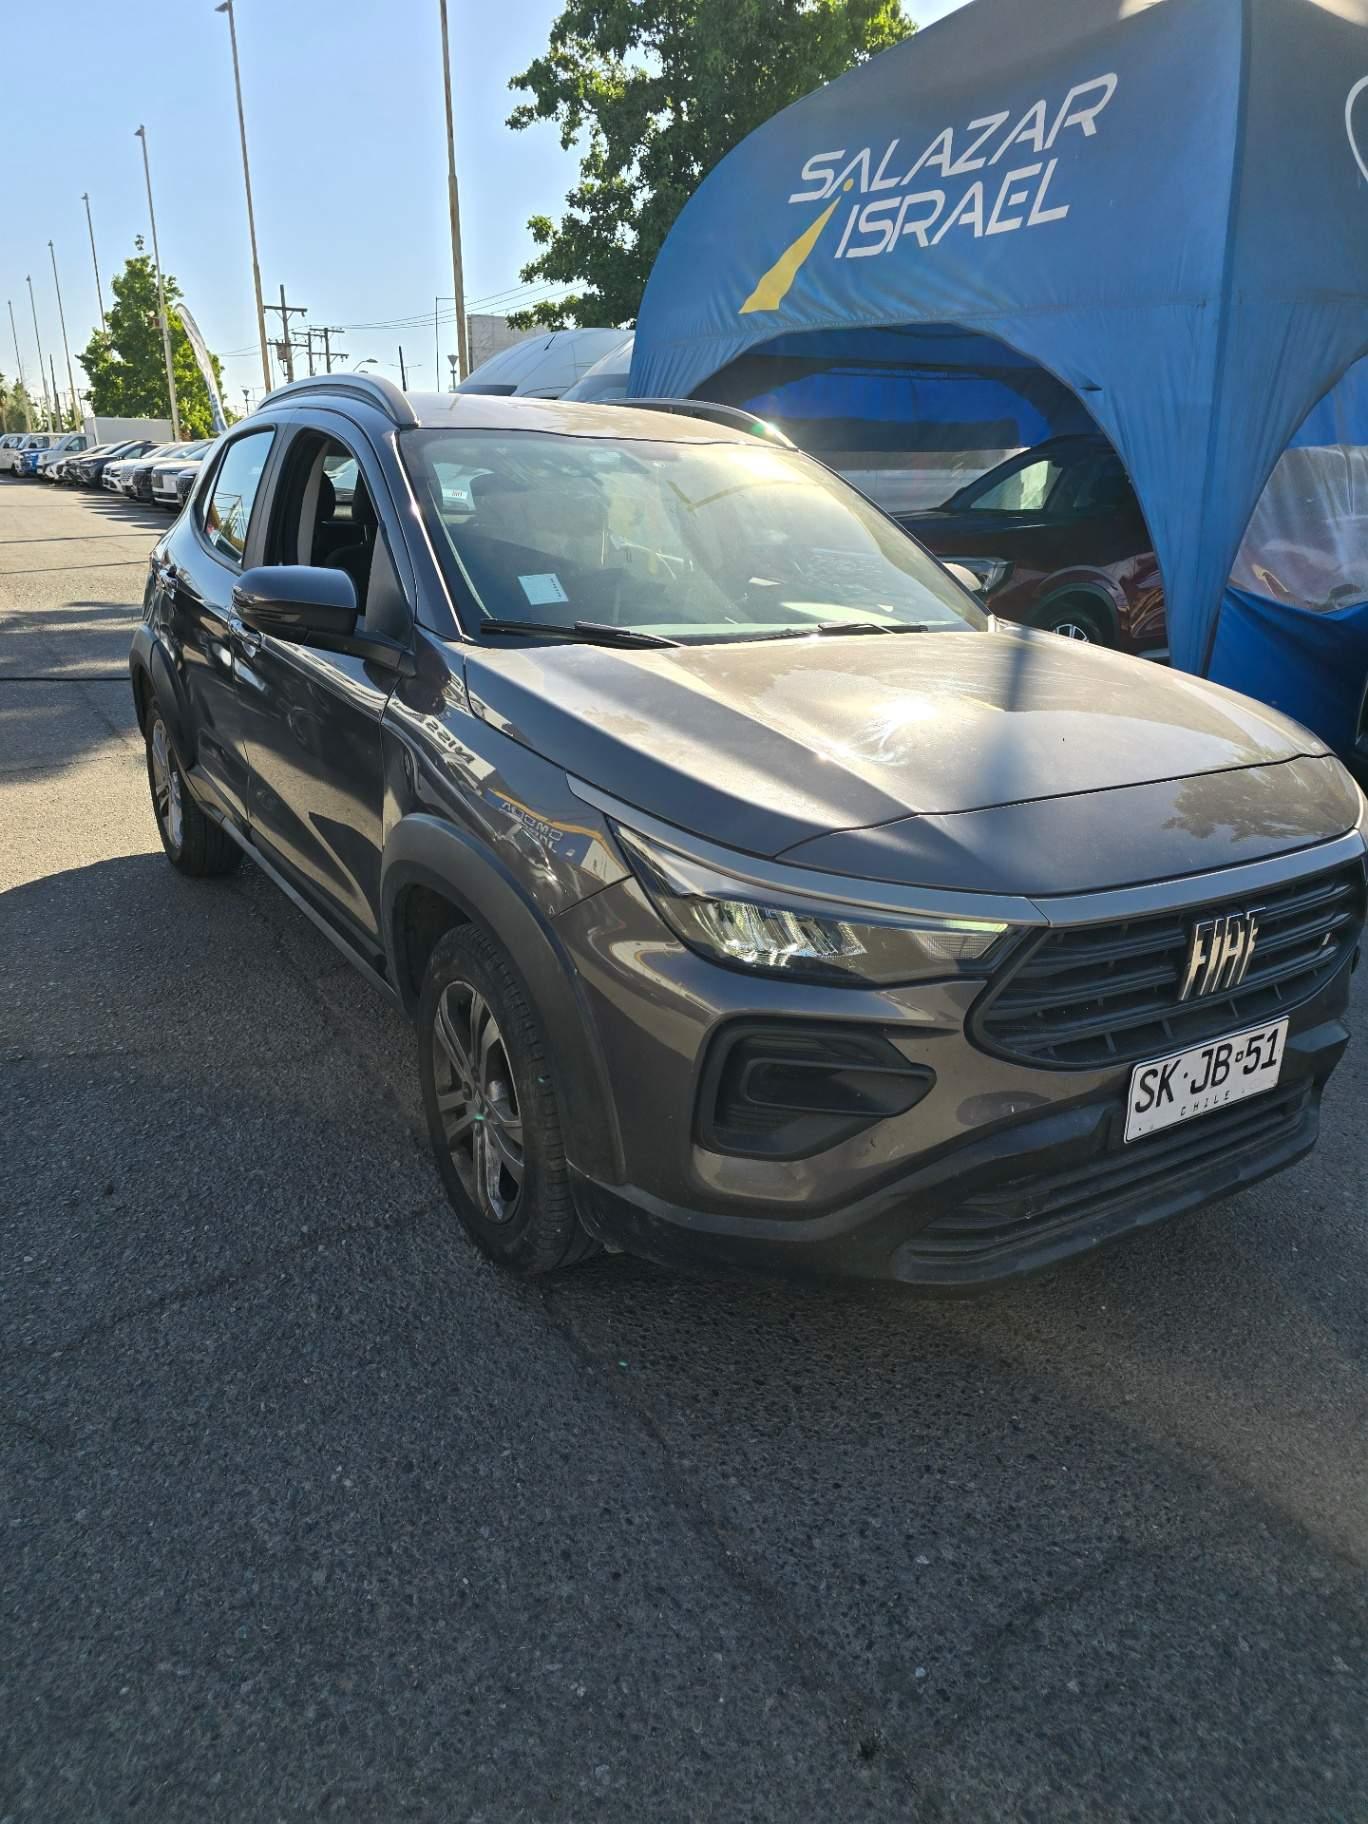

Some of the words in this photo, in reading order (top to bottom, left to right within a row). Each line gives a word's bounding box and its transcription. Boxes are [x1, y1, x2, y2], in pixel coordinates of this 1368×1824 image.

[788, 72, 1117, 203] SALAZAR
[834, 158, 1071, 259] ISRAEL
[1181, 907, 1266, 1001] FIAT
[1180, 1090, 1230, 1116] CHILE
